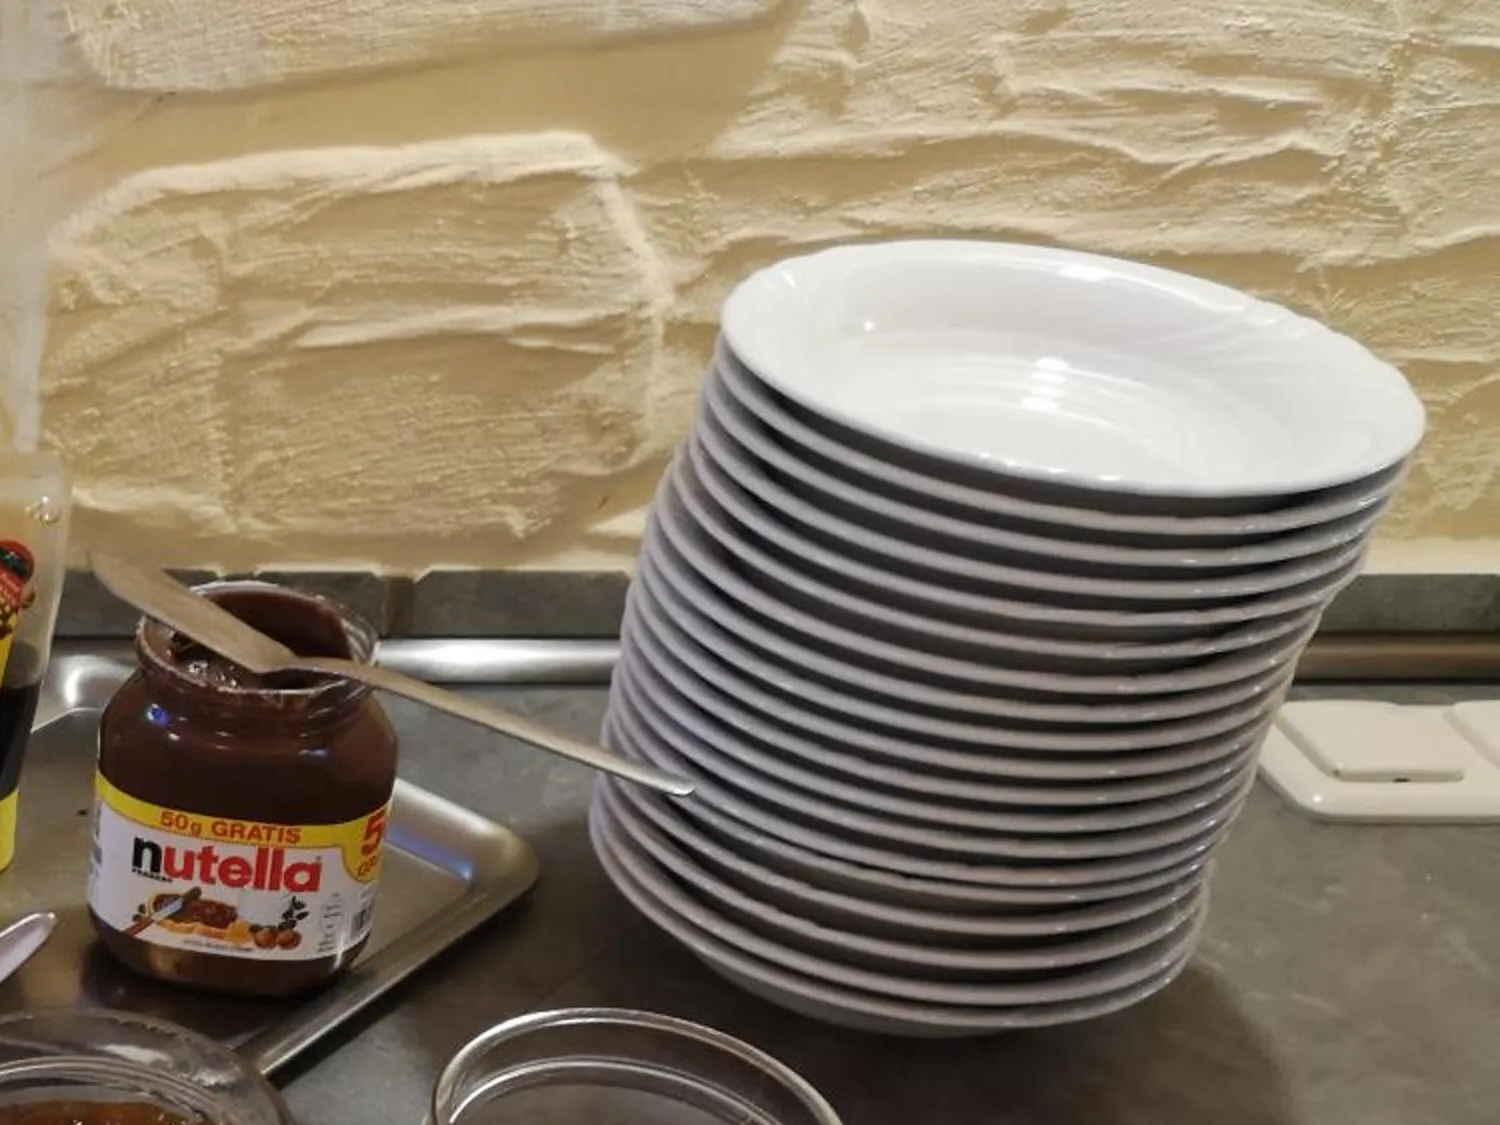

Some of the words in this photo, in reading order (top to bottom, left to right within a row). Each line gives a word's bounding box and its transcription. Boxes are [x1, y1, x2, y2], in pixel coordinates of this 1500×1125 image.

[160, 811, 203, 836] 50g
[211, 821, 302, 843] GRATIS
[131, 836, 323, 893] nutella
